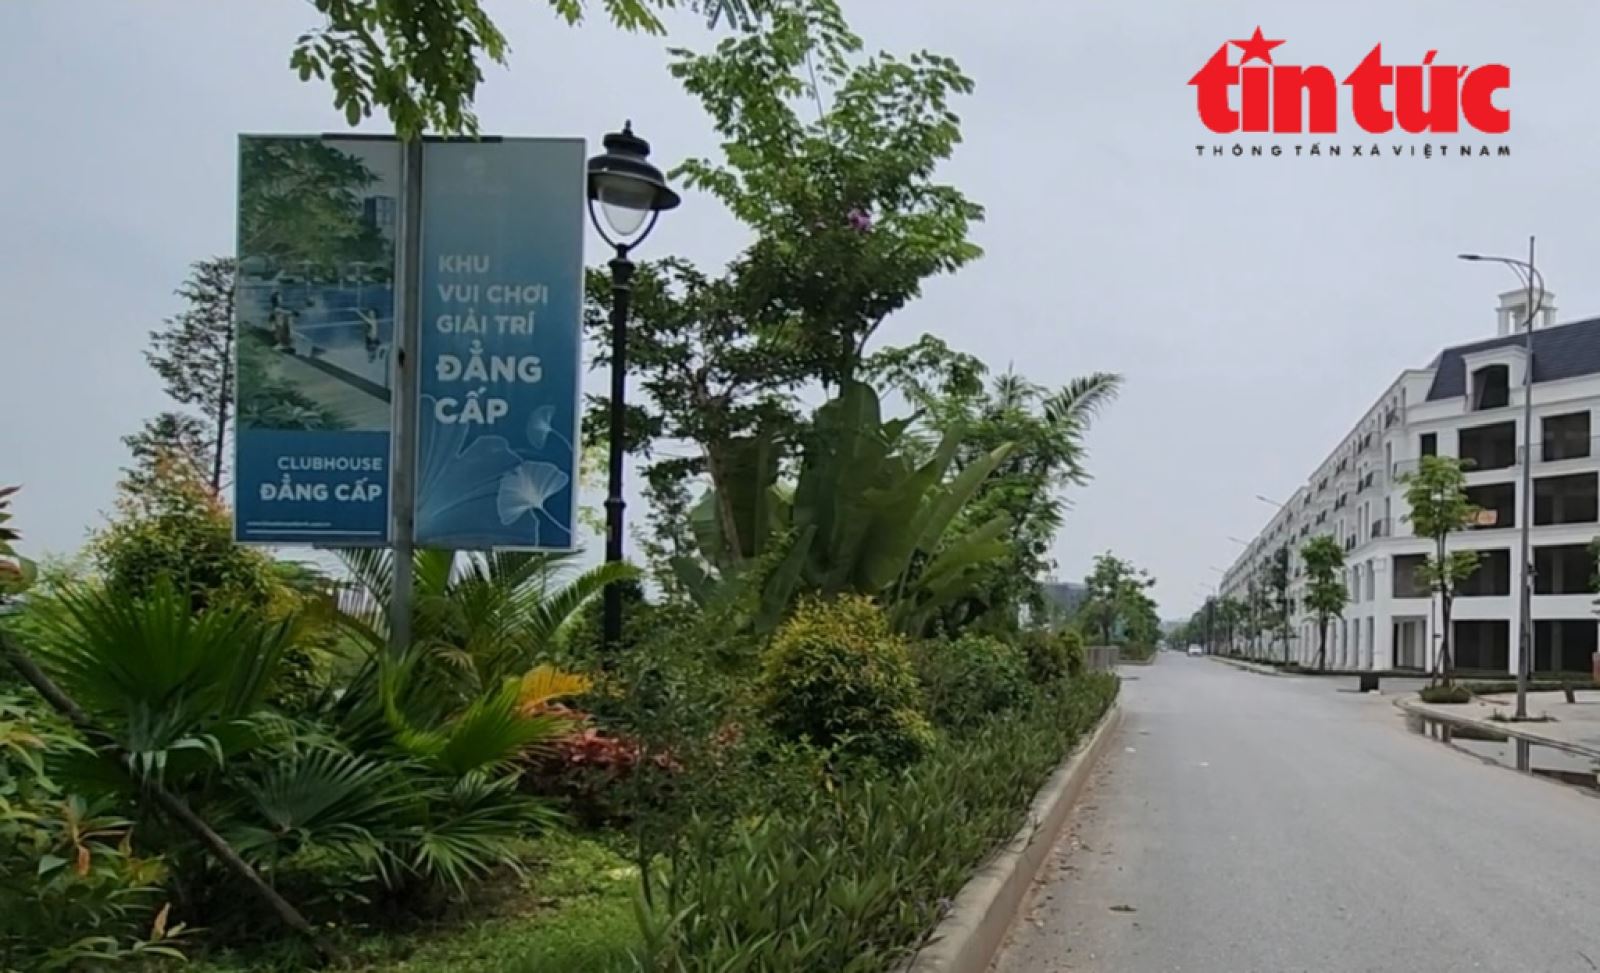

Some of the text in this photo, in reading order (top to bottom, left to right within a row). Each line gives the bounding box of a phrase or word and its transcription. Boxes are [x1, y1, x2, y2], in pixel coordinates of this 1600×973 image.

[438, 254, 490, 273] KHU
[438, 283, 548, 304] VUI CHƠI
[436, 308, 535, 335] GIẢI TRÍ
[436, 339, 542, 383] ĐẲNG
[435, 386, 509, 424] CẤP
[277, 455, 383, 471] CLUBHOUSE
[259, 472, 383, 502] ĐẲNG CẤP
